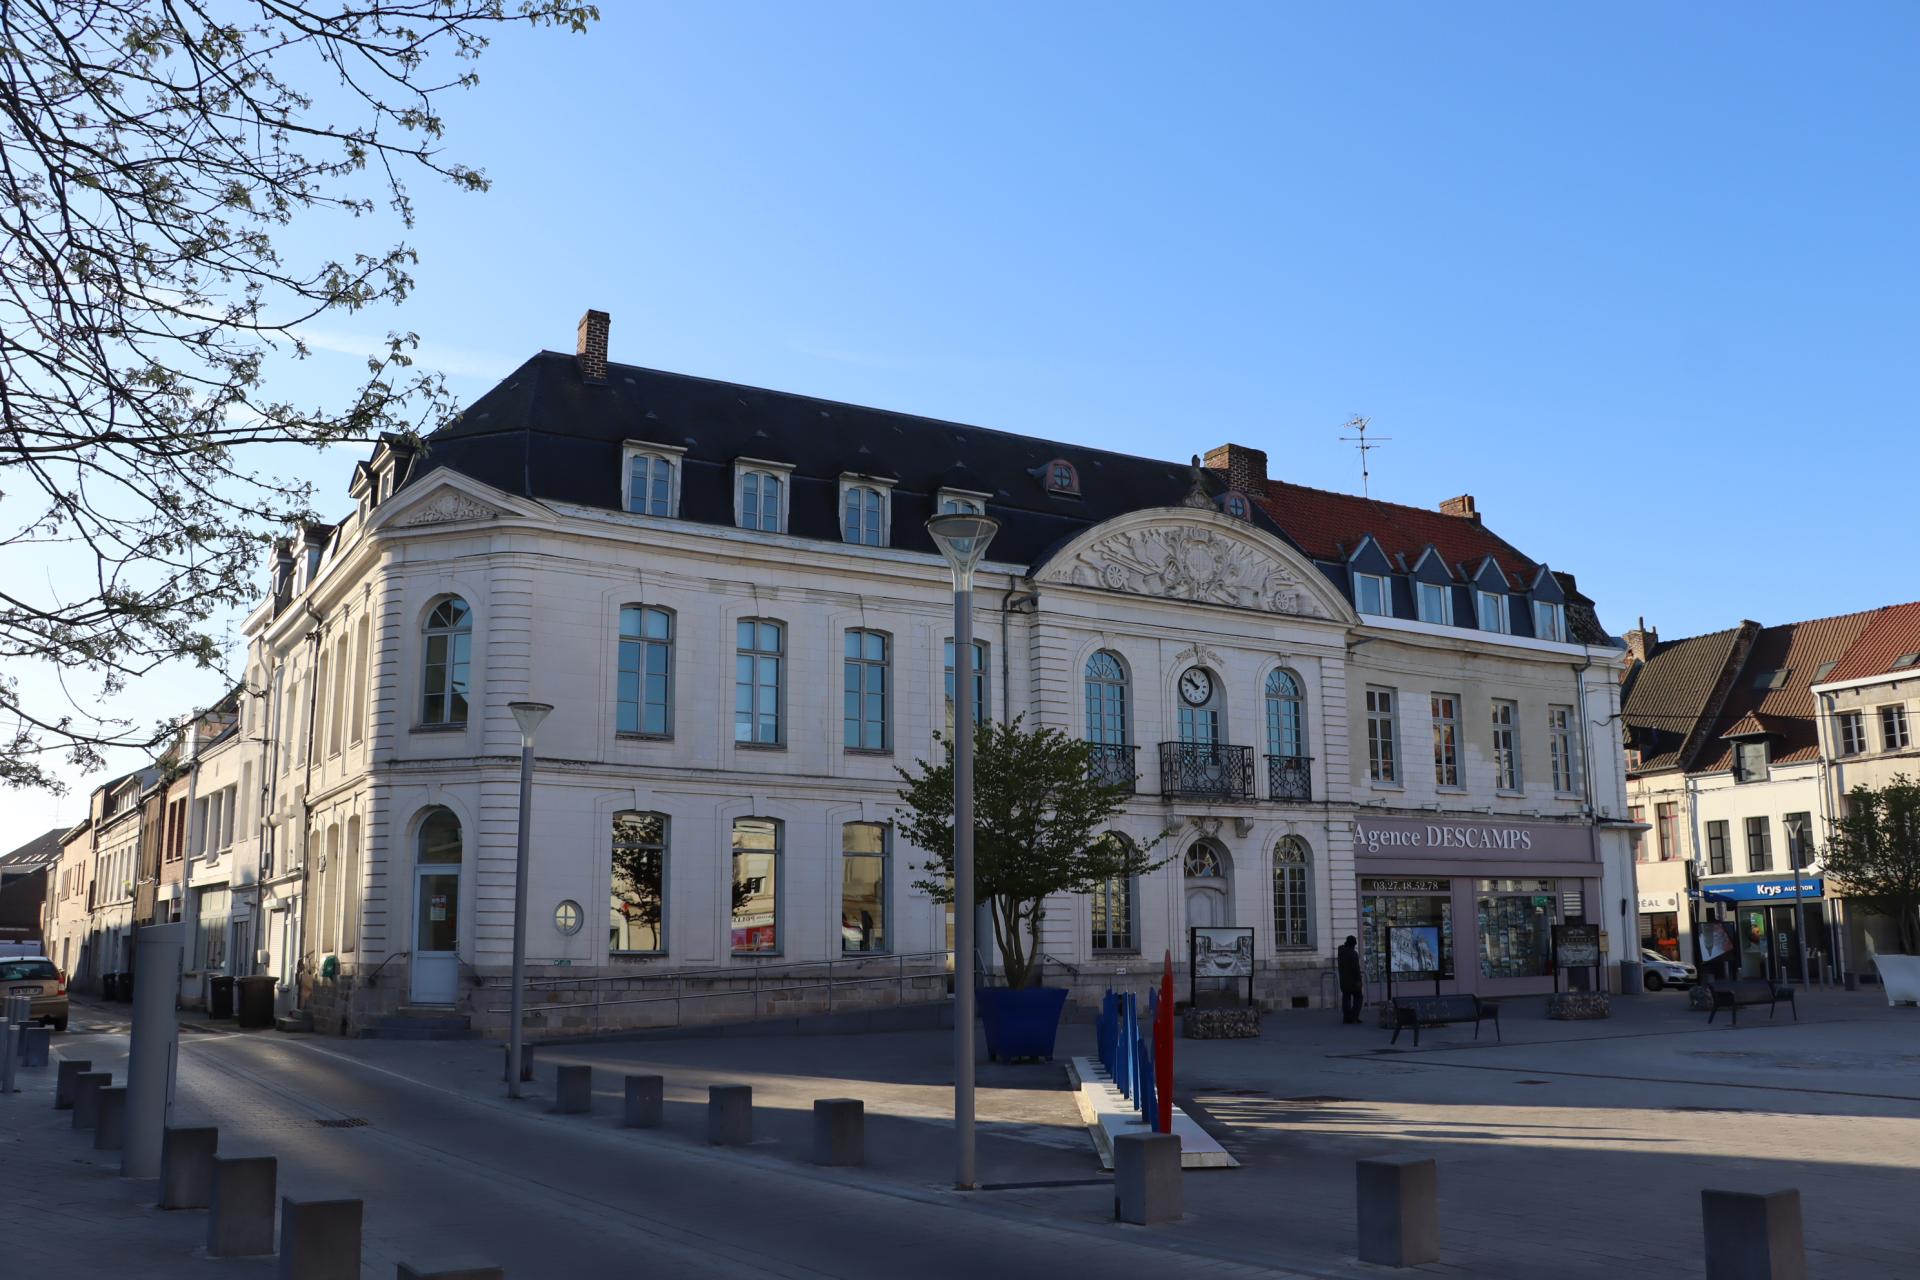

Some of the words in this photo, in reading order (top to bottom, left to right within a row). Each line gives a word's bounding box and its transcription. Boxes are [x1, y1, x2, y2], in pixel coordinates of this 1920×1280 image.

[1353, 823, 1421, 852] Agence
[1426, 825, 1531, 850] DESCAMPS
[1756, 885, 1782, 896] Krys
